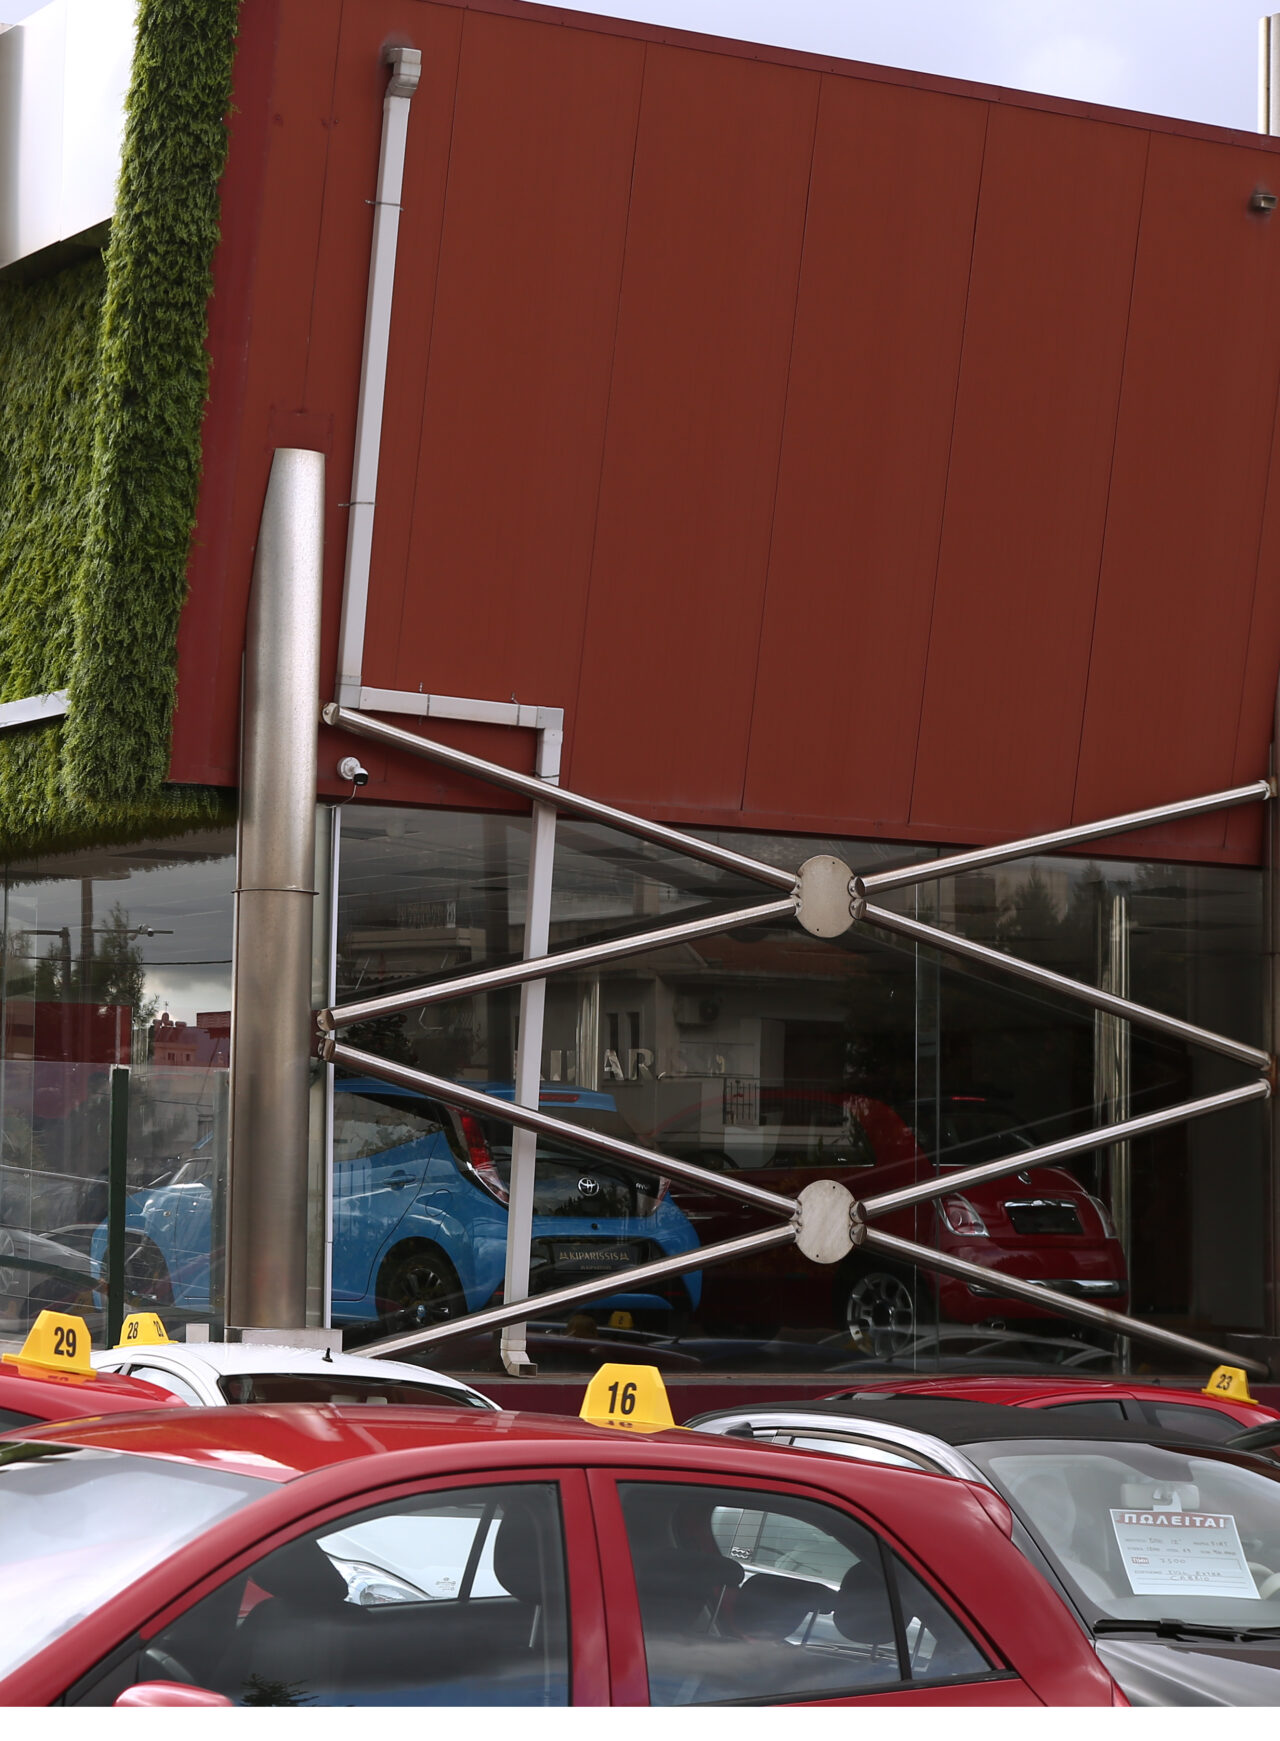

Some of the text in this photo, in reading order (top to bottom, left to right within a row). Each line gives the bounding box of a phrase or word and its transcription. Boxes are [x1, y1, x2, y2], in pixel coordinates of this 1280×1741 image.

[569, 1251, 619, 1261] KIPARISSIS
[127, 1321, 139, 1340] 28
[54, 1326, 77, 1358] 29
[1216, 1373, 1233, 1391] 23
[608, 1381, 637, 1416] 16
[1124, 1513, 1225, 1529] ΠΩΛΕΙΤΑΙ
